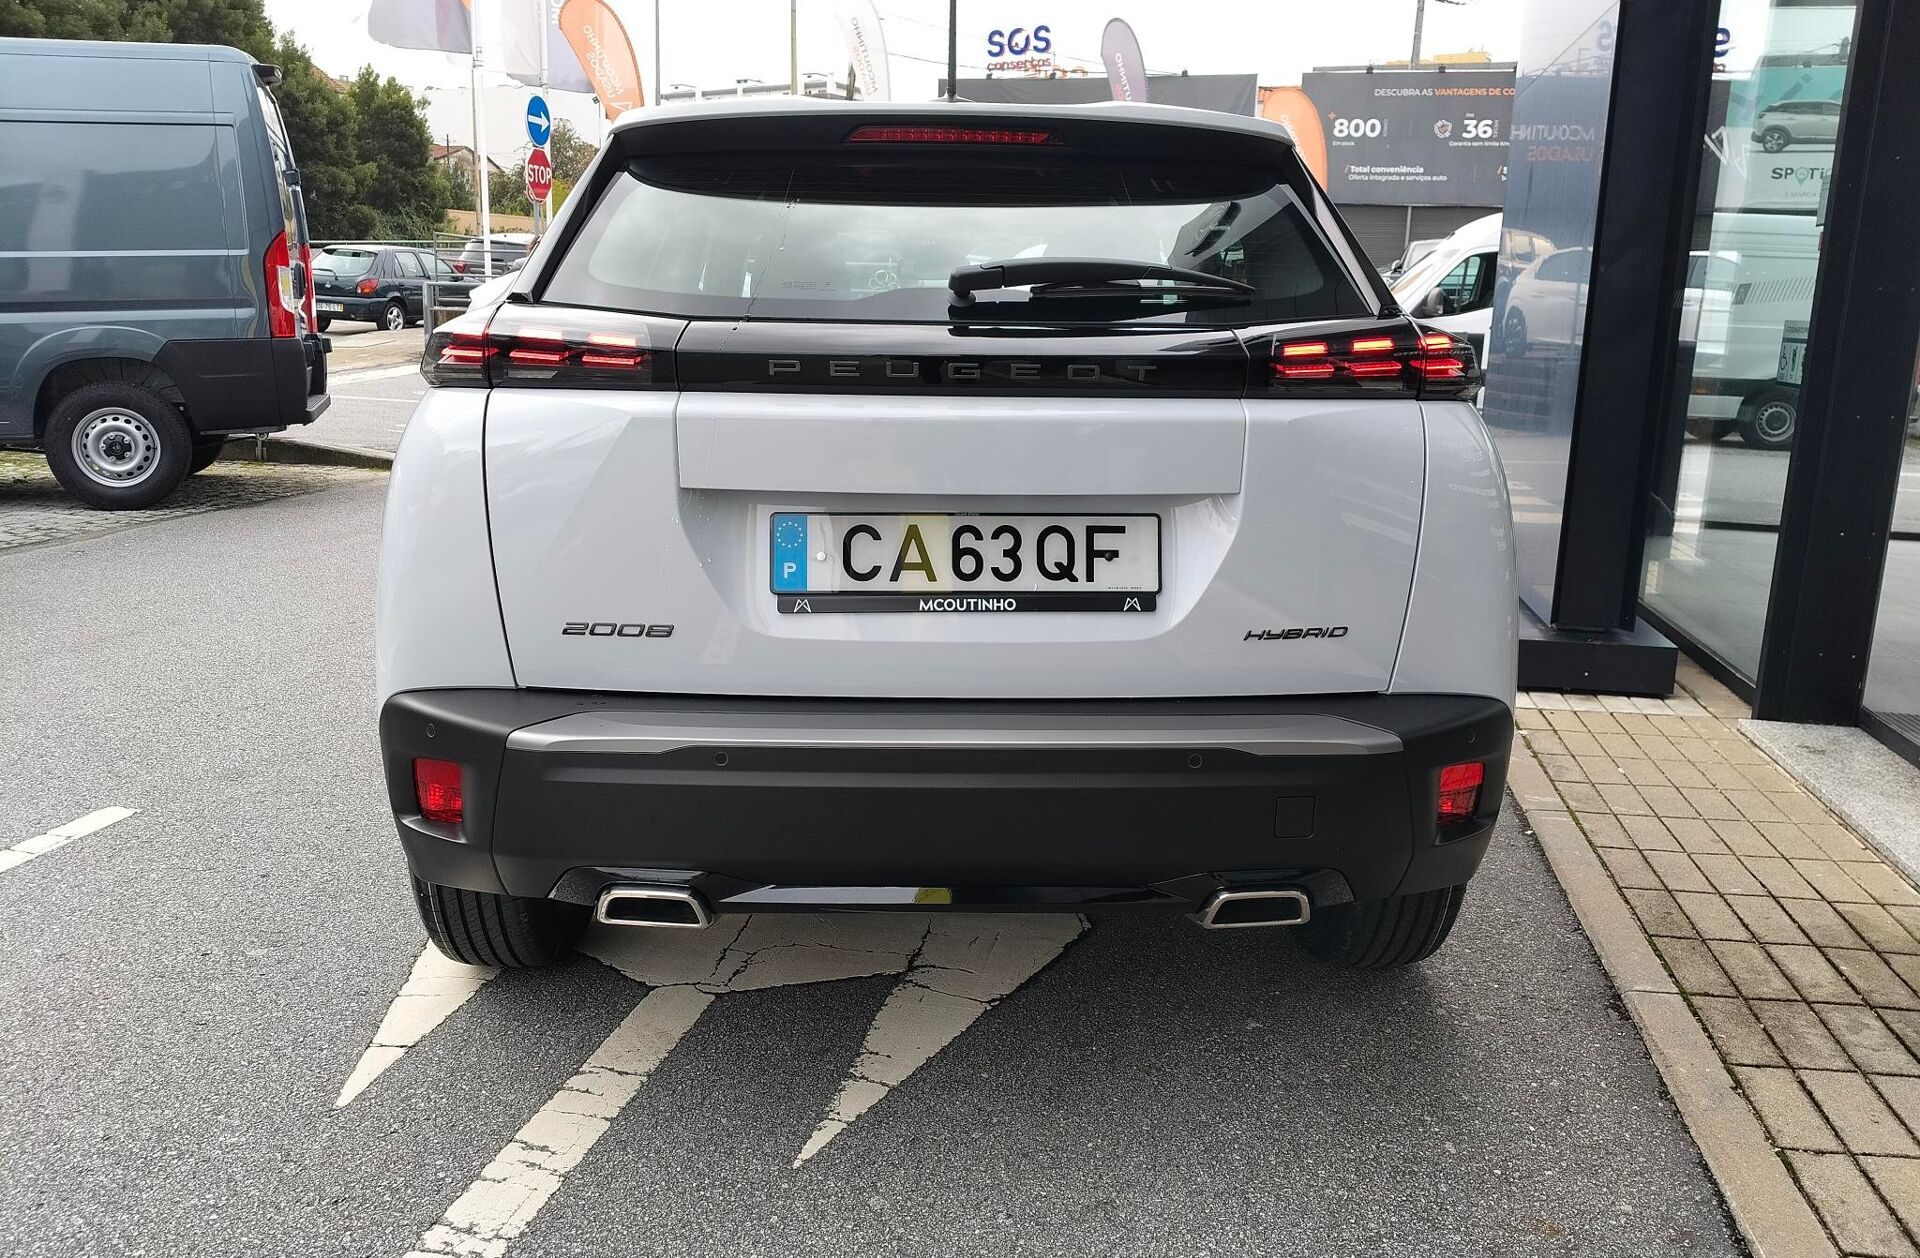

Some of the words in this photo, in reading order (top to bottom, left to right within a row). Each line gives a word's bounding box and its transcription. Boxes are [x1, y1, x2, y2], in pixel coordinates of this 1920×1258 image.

[987, 25, 1051, 57] SOS
[1374, 88, 1420, 96] DESCUBRA
[1421, 88, 1433, 96] AS
[1434, 88, 1488, 96] VANTAGENS
[1489, 88, 1501, 96] DE
[1462, 119, 1493, 139] 36
[528, 164, 551, 184] STOP
[1351, 165, 1370, 173] Total
[1372, 165, 1424, 173] conveniência
[768, 359, 1158, 381] PEUGEOT
[783, 562, 796, 579] P
[919, 598, 1016, 612] MCOUTINHO
[562, 621, 674, 637] 2008
[1243, 626, 1349, 641] HYBRID
